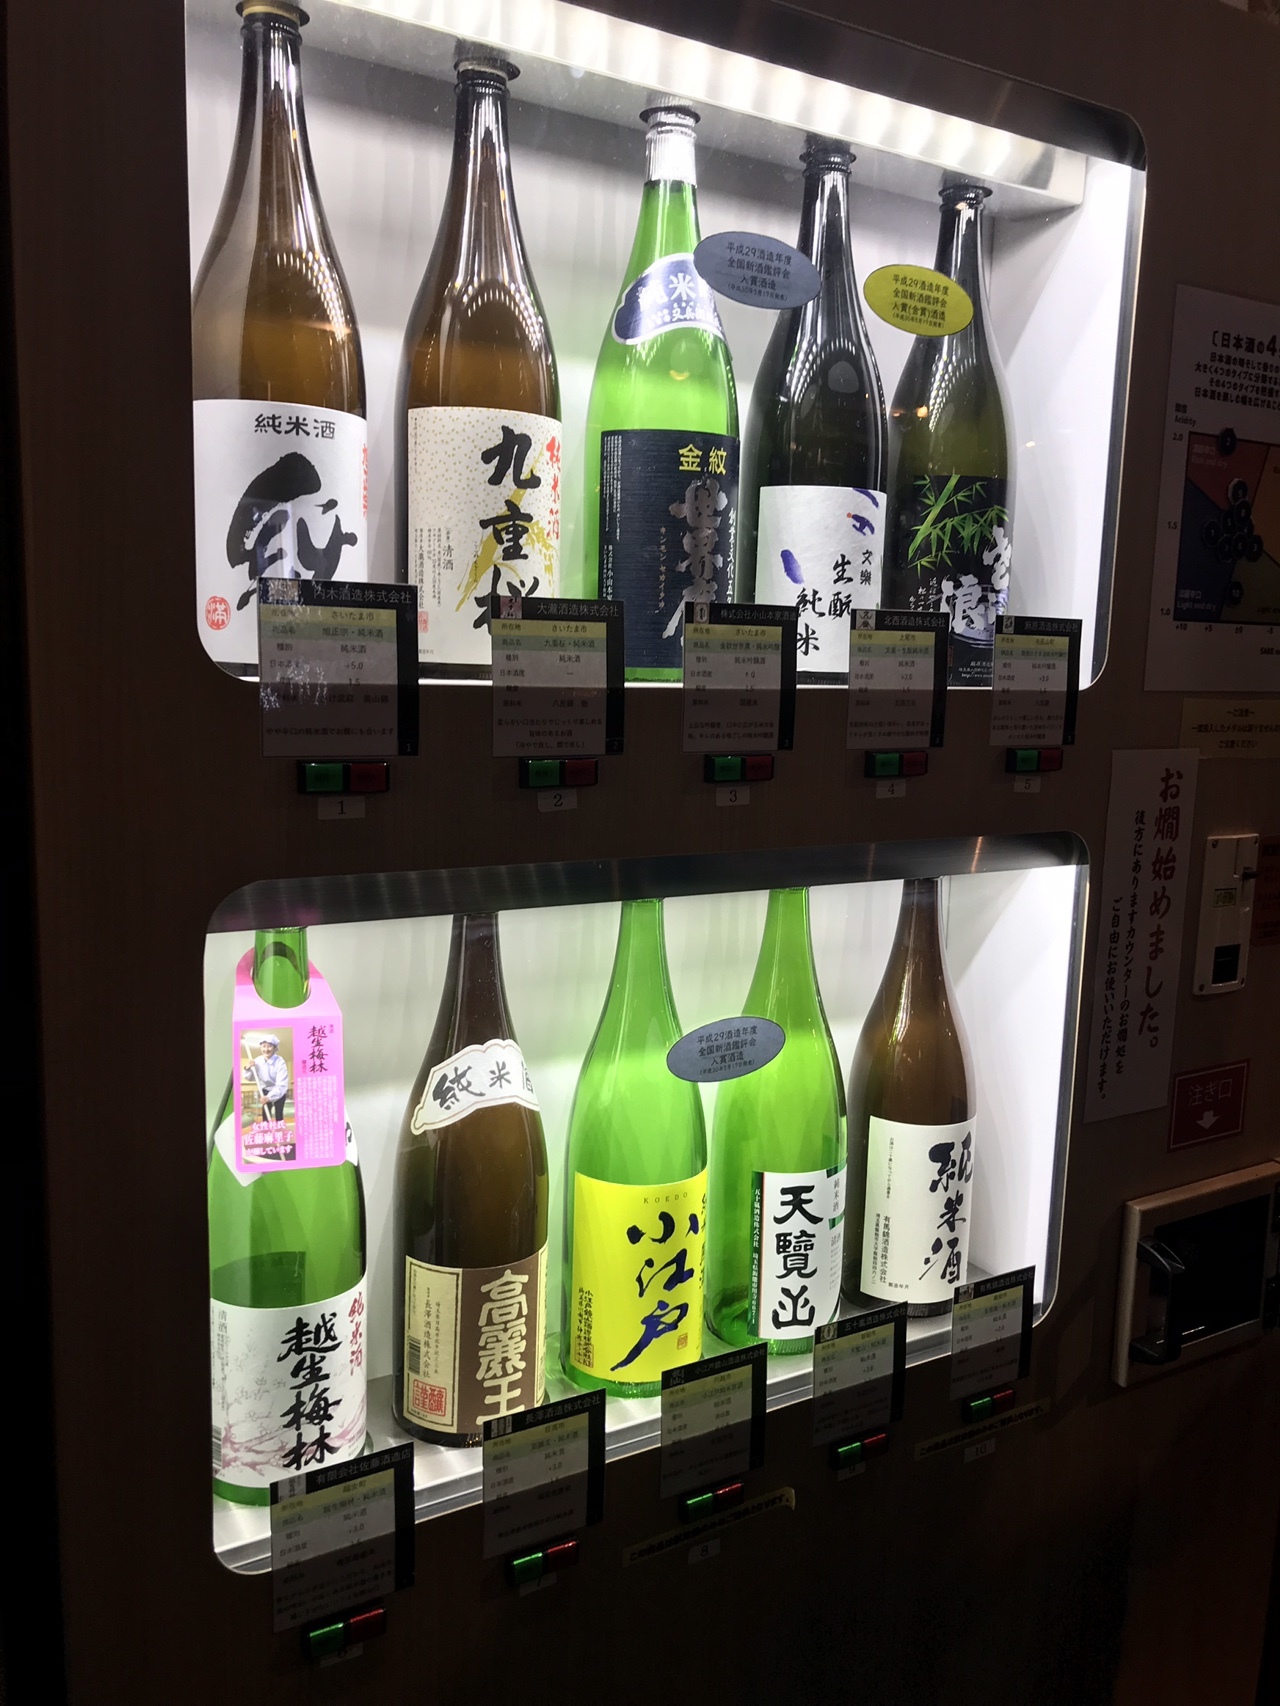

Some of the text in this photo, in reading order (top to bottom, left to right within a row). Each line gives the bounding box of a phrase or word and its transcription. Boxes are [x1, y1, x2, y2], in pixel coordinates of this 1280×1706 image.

[727, 242, 792, 267] 平成29酒造年度
[727, 256, 791, 280] 全国新酒鑑評会
[740, 276, 776, 292] 入賞酒造
[892, 274, 949, 297] 平成29酒造年度
[893, 287, 947, 309] 全国新酒鑑評会
[892, 302, 946, 323] 入賞(金賞)酒造
[255, 413, 336, 441] 純米酒
[1172, 432, 1184, 442] 2.0
[678, 442, 727, 476] 金紋
[1167, 520, 1178, 534] 1.5
[443, 544, 455, 571] 清酒
[314, 585, 412, 605] 内木酒造株式会社
[332, 611, 375, 621] さいたま市
[796, 587, 827, 657] 純米
[322, 628, 384, 639] 旭正宗・純米酒
[501, 622, 588, 634] 所在地 さいたま市
[692, 626, 767, 637] 所在地 さいたま市
[340, 643, 368, 655] 純米酒
[544, 639, 595, 649] 九重桜・純米酒
[345, 660, 364, 670] +5.0
[505, 653, 581, 664] 種別 純米酒
[499, 669, 526, 678] 日本酒度
[886, 783, 896, 796] 4
[1023, 778, 1032, 791] 5
[552, 793, 563, 808] 2
[729, 789, 738, 803] 3
[338, 800, 346, 815] 1
[1139, 767, 1183, 1048] お燗始めました。
[1097, 896, 1123, 1100] ご自由にお使いいただけます。
[697, 1025, 758, 1046] 平成29酒造年度
[306, 1025, 329, 1073] 越生梅林
[698, 1037, 756, 1057] 全国新酒鑑評会
[711, 1051, 744, 1067] 入賞酒造
[432, 1060, 534, 1111] 純米酒
[1187, 1078, 1233, 1108] 注ぎ口
[643, 1193, 689, 1204] KOEDO
[918, 1131, 974, 1285] 純米酒
[610, 1210, 700, 1372] 小江戸
[475, 1268, 530, 1425] 高麗王
[277, 1311, 343, 1471] 越生梅林
[525, 1394, 602, 1425] 長澤酒造株式会社
[316, 1452, 412, 1485] 有限会社佐藤酒造店
[700, 1544, 709, 1557] 8
